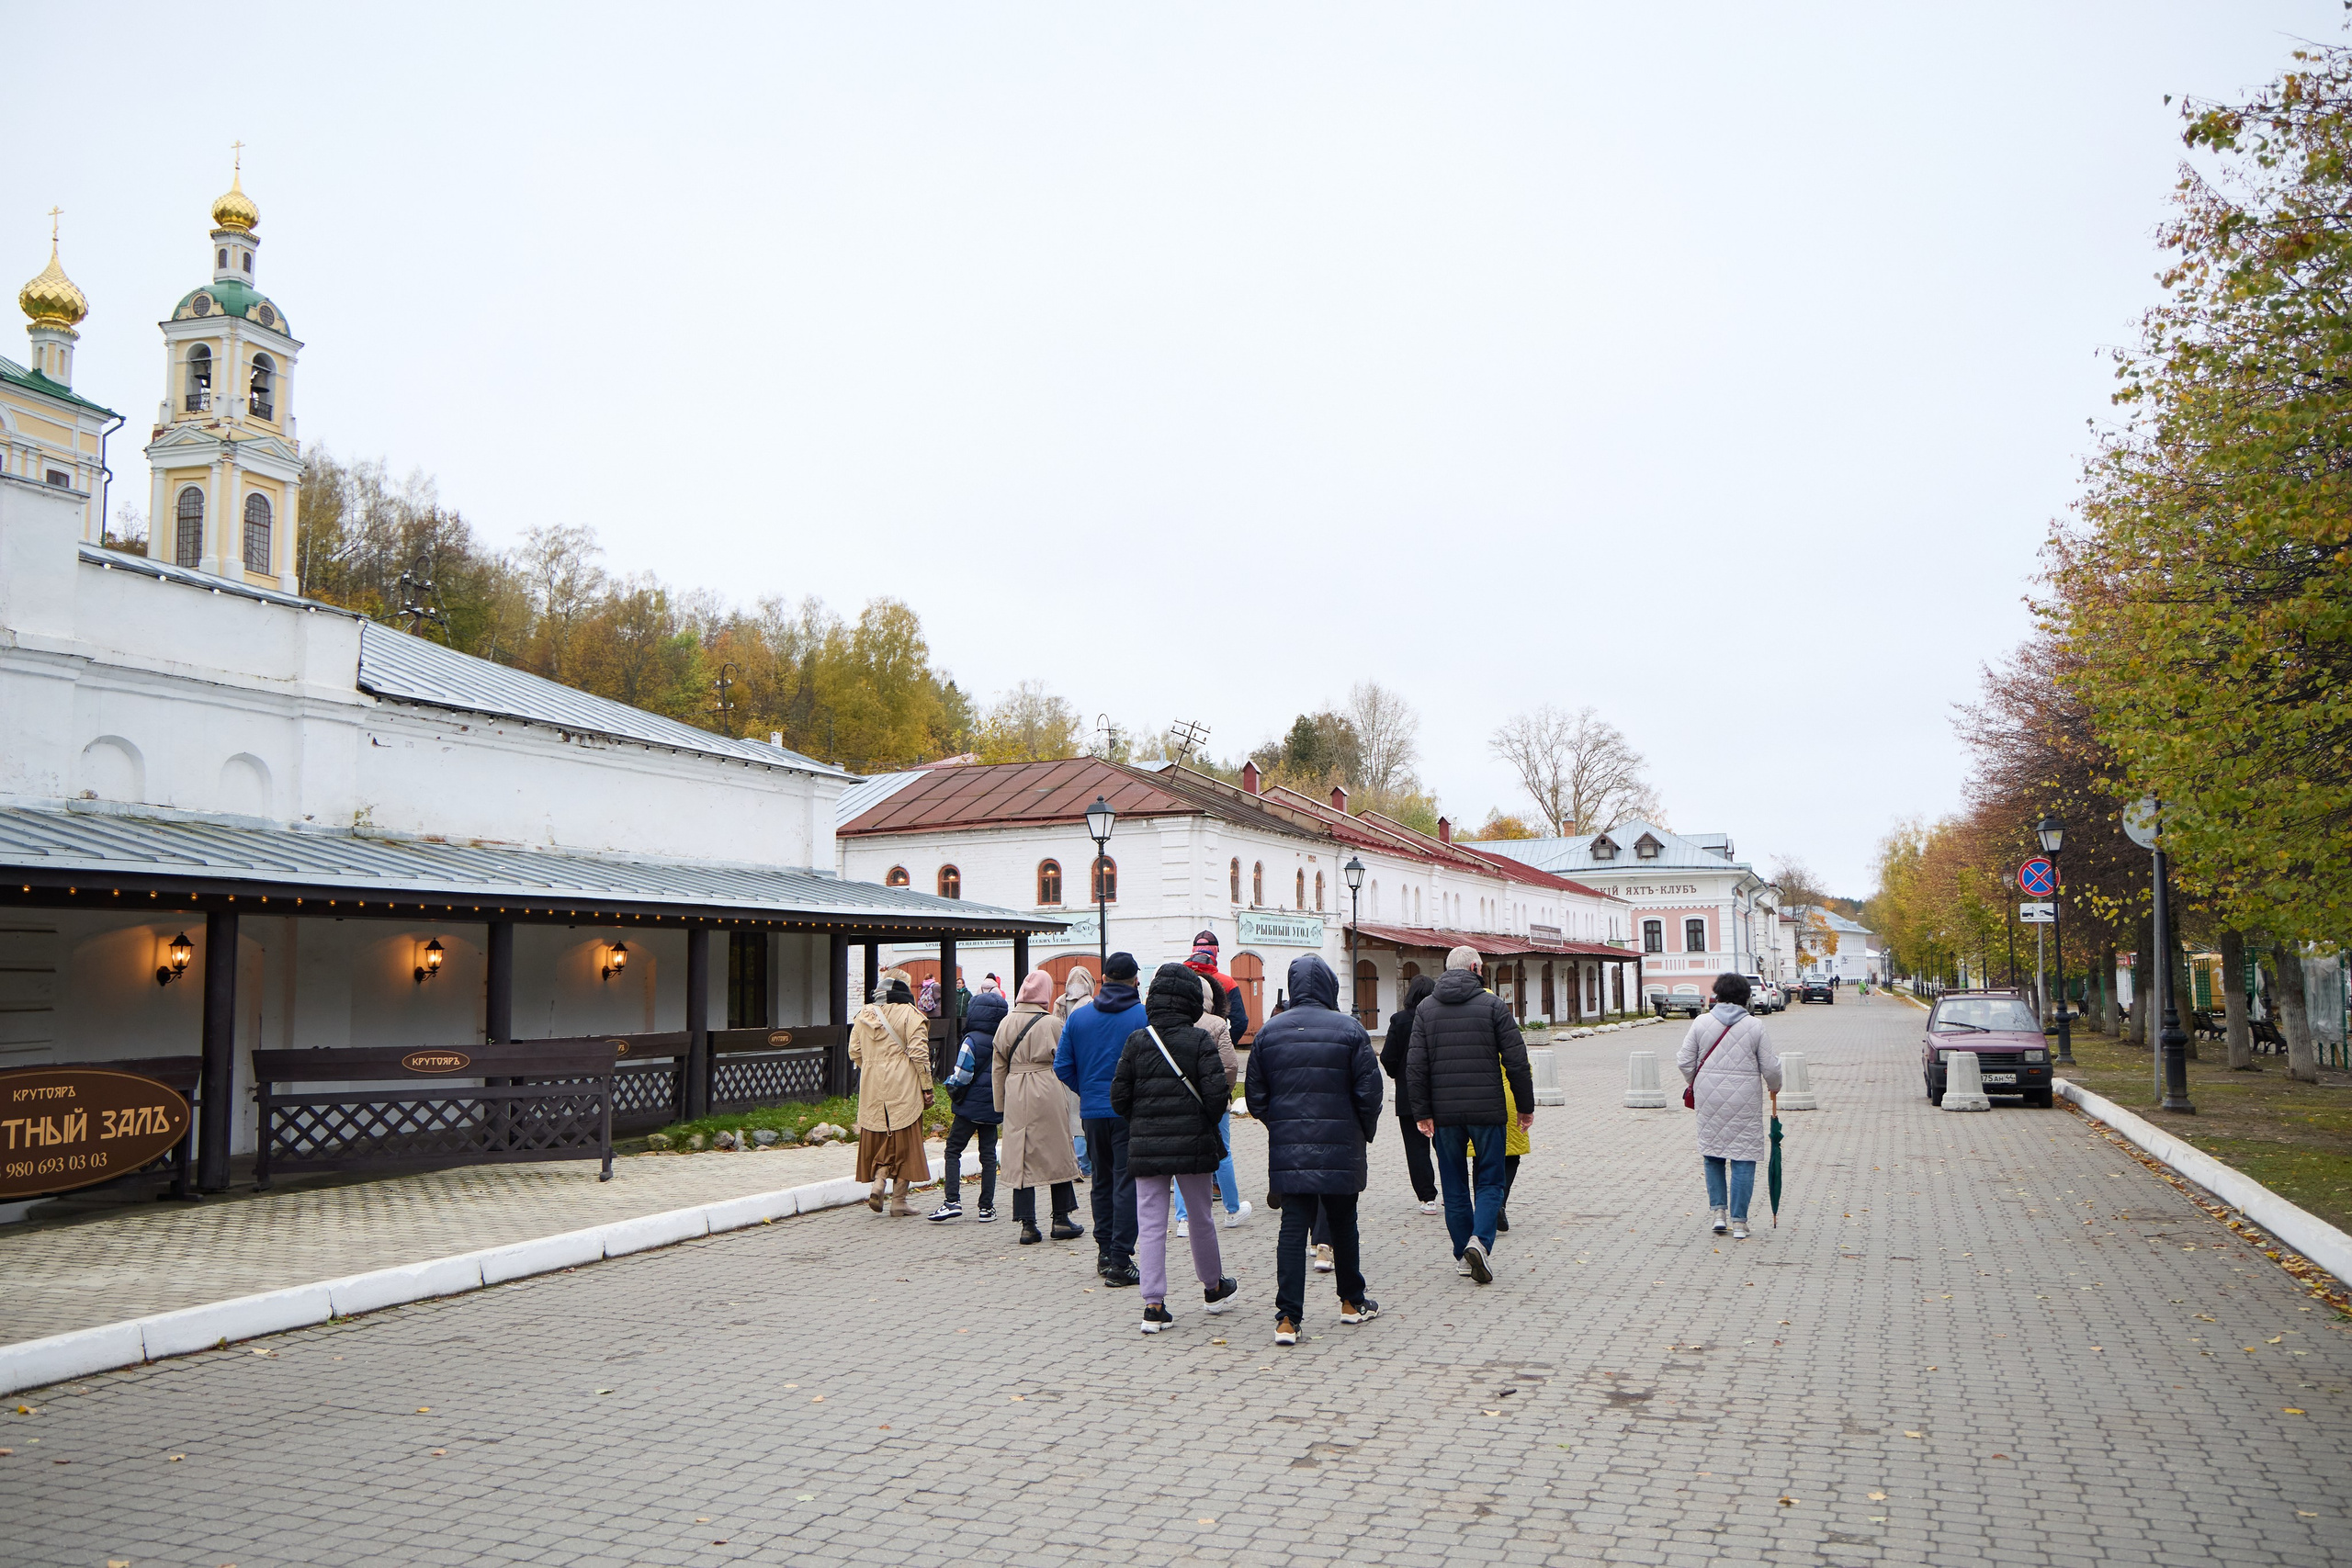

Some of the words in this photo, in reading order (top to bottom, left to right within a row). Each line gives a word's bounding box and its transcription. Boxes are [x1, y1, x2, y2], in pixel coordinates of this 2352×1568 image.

[1625, 885, 1697, 896] ЯХТЪ-КЛУБЪ
[1256, 923, 1290, 937] РЫБНЫЙ
[1292, 926, 1309, 938] УГОЛ
[412, 1056, 460, 1066] КРУТОЯРЪ
[13, 1086, 76, 1102] КРУТОЯРЪ
[100, 1105, 171, 1140] ЗАЛЪ
[6, 1160, 34, 1179] 980
[38, 1156, 64, 1175] 693
[69, 1154, 86, 1171] 03
[90, 1152, 108, 1168] 03
